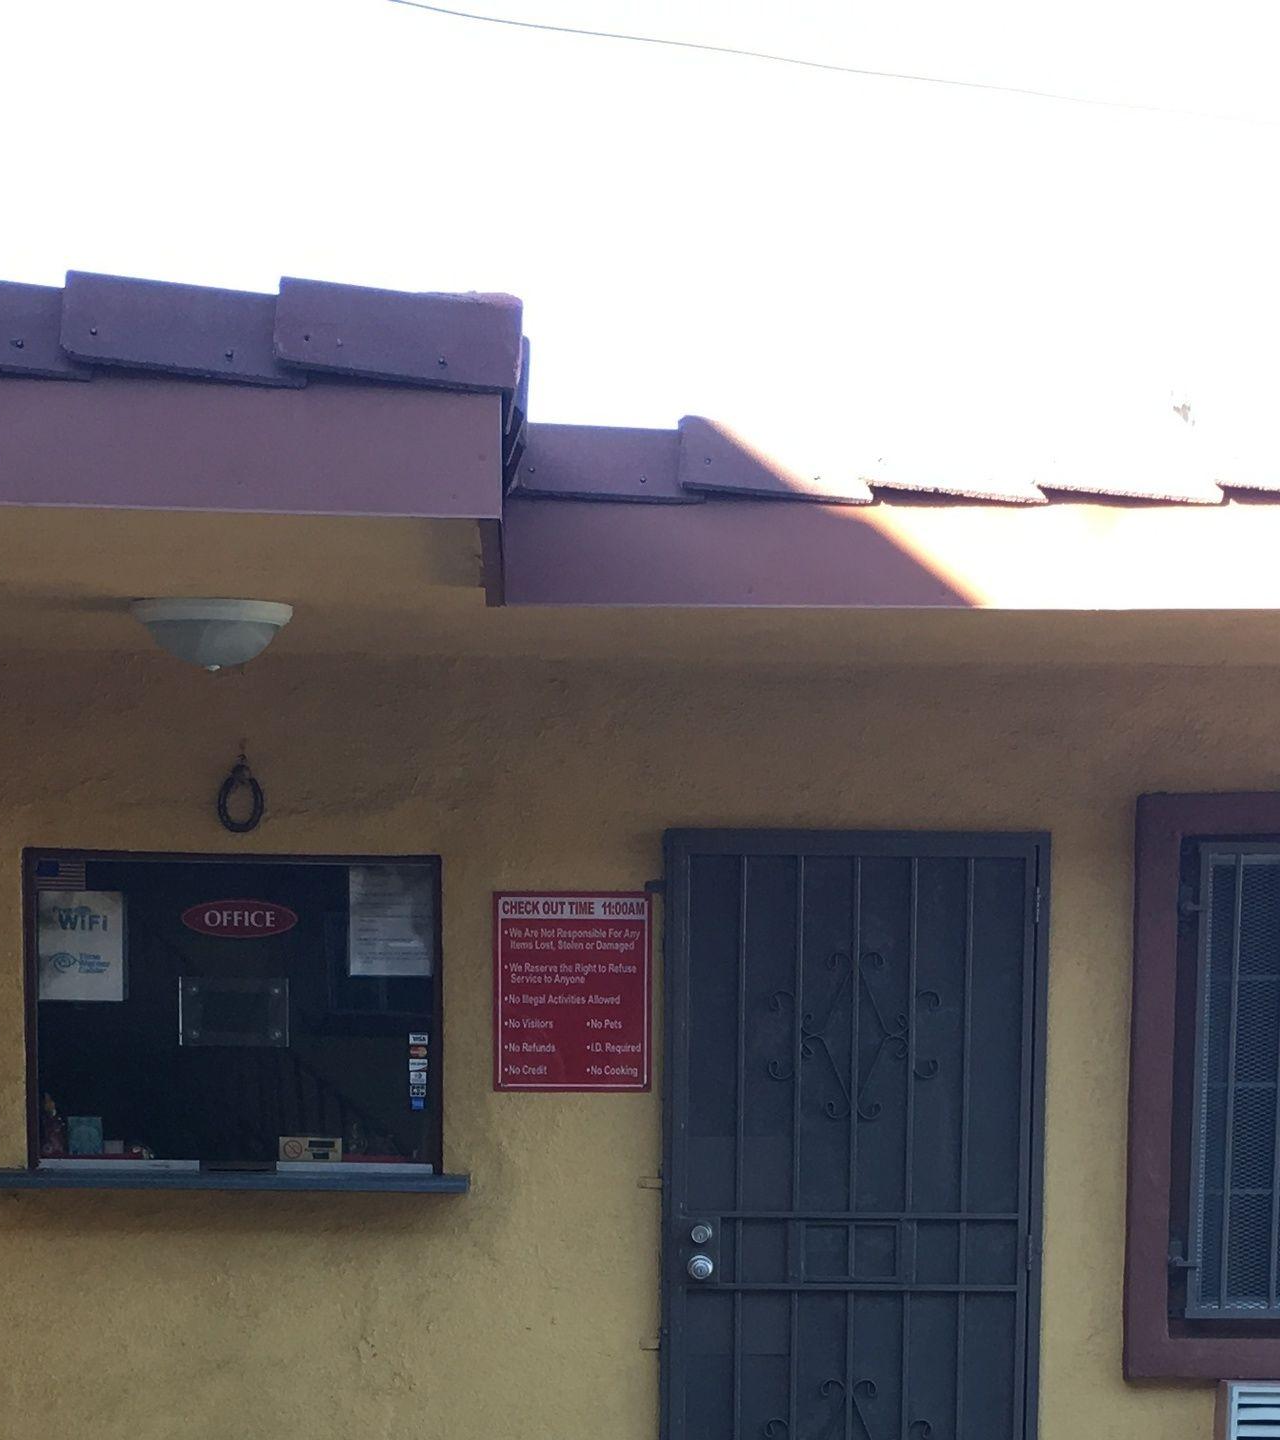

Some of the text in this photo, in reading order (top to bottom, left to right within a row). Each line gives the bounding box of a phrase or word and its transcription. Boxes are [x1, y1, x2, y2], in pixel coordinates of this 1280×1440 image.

[502, 901, 645, 915] CHECK OUT TIME 11:00AM
[203, 910, 276, 928] OFFICE
[509, 928, 640, 941] We Are Not Responsible For Any
[510, 940, 634, 953] Items Lost, Stolen or Damaged
[509, 963, 637, 975] We Reserve the Right to Refuse
[510, 974, 585, 986] Service to Anyone
[508, 994, 621, 1006] No Illegal Activities Allowed
[508, 1019, 554, 1029] No Visitors
[590, 1019, 622, 1029] No Pets
[508, 1043, 556, 1053] No Refunds
[605, 1043, 642, 1054] Required
[508, 1065, 547, 1075] No Credit
[590, 1065, 638, 1077] No Cooking
